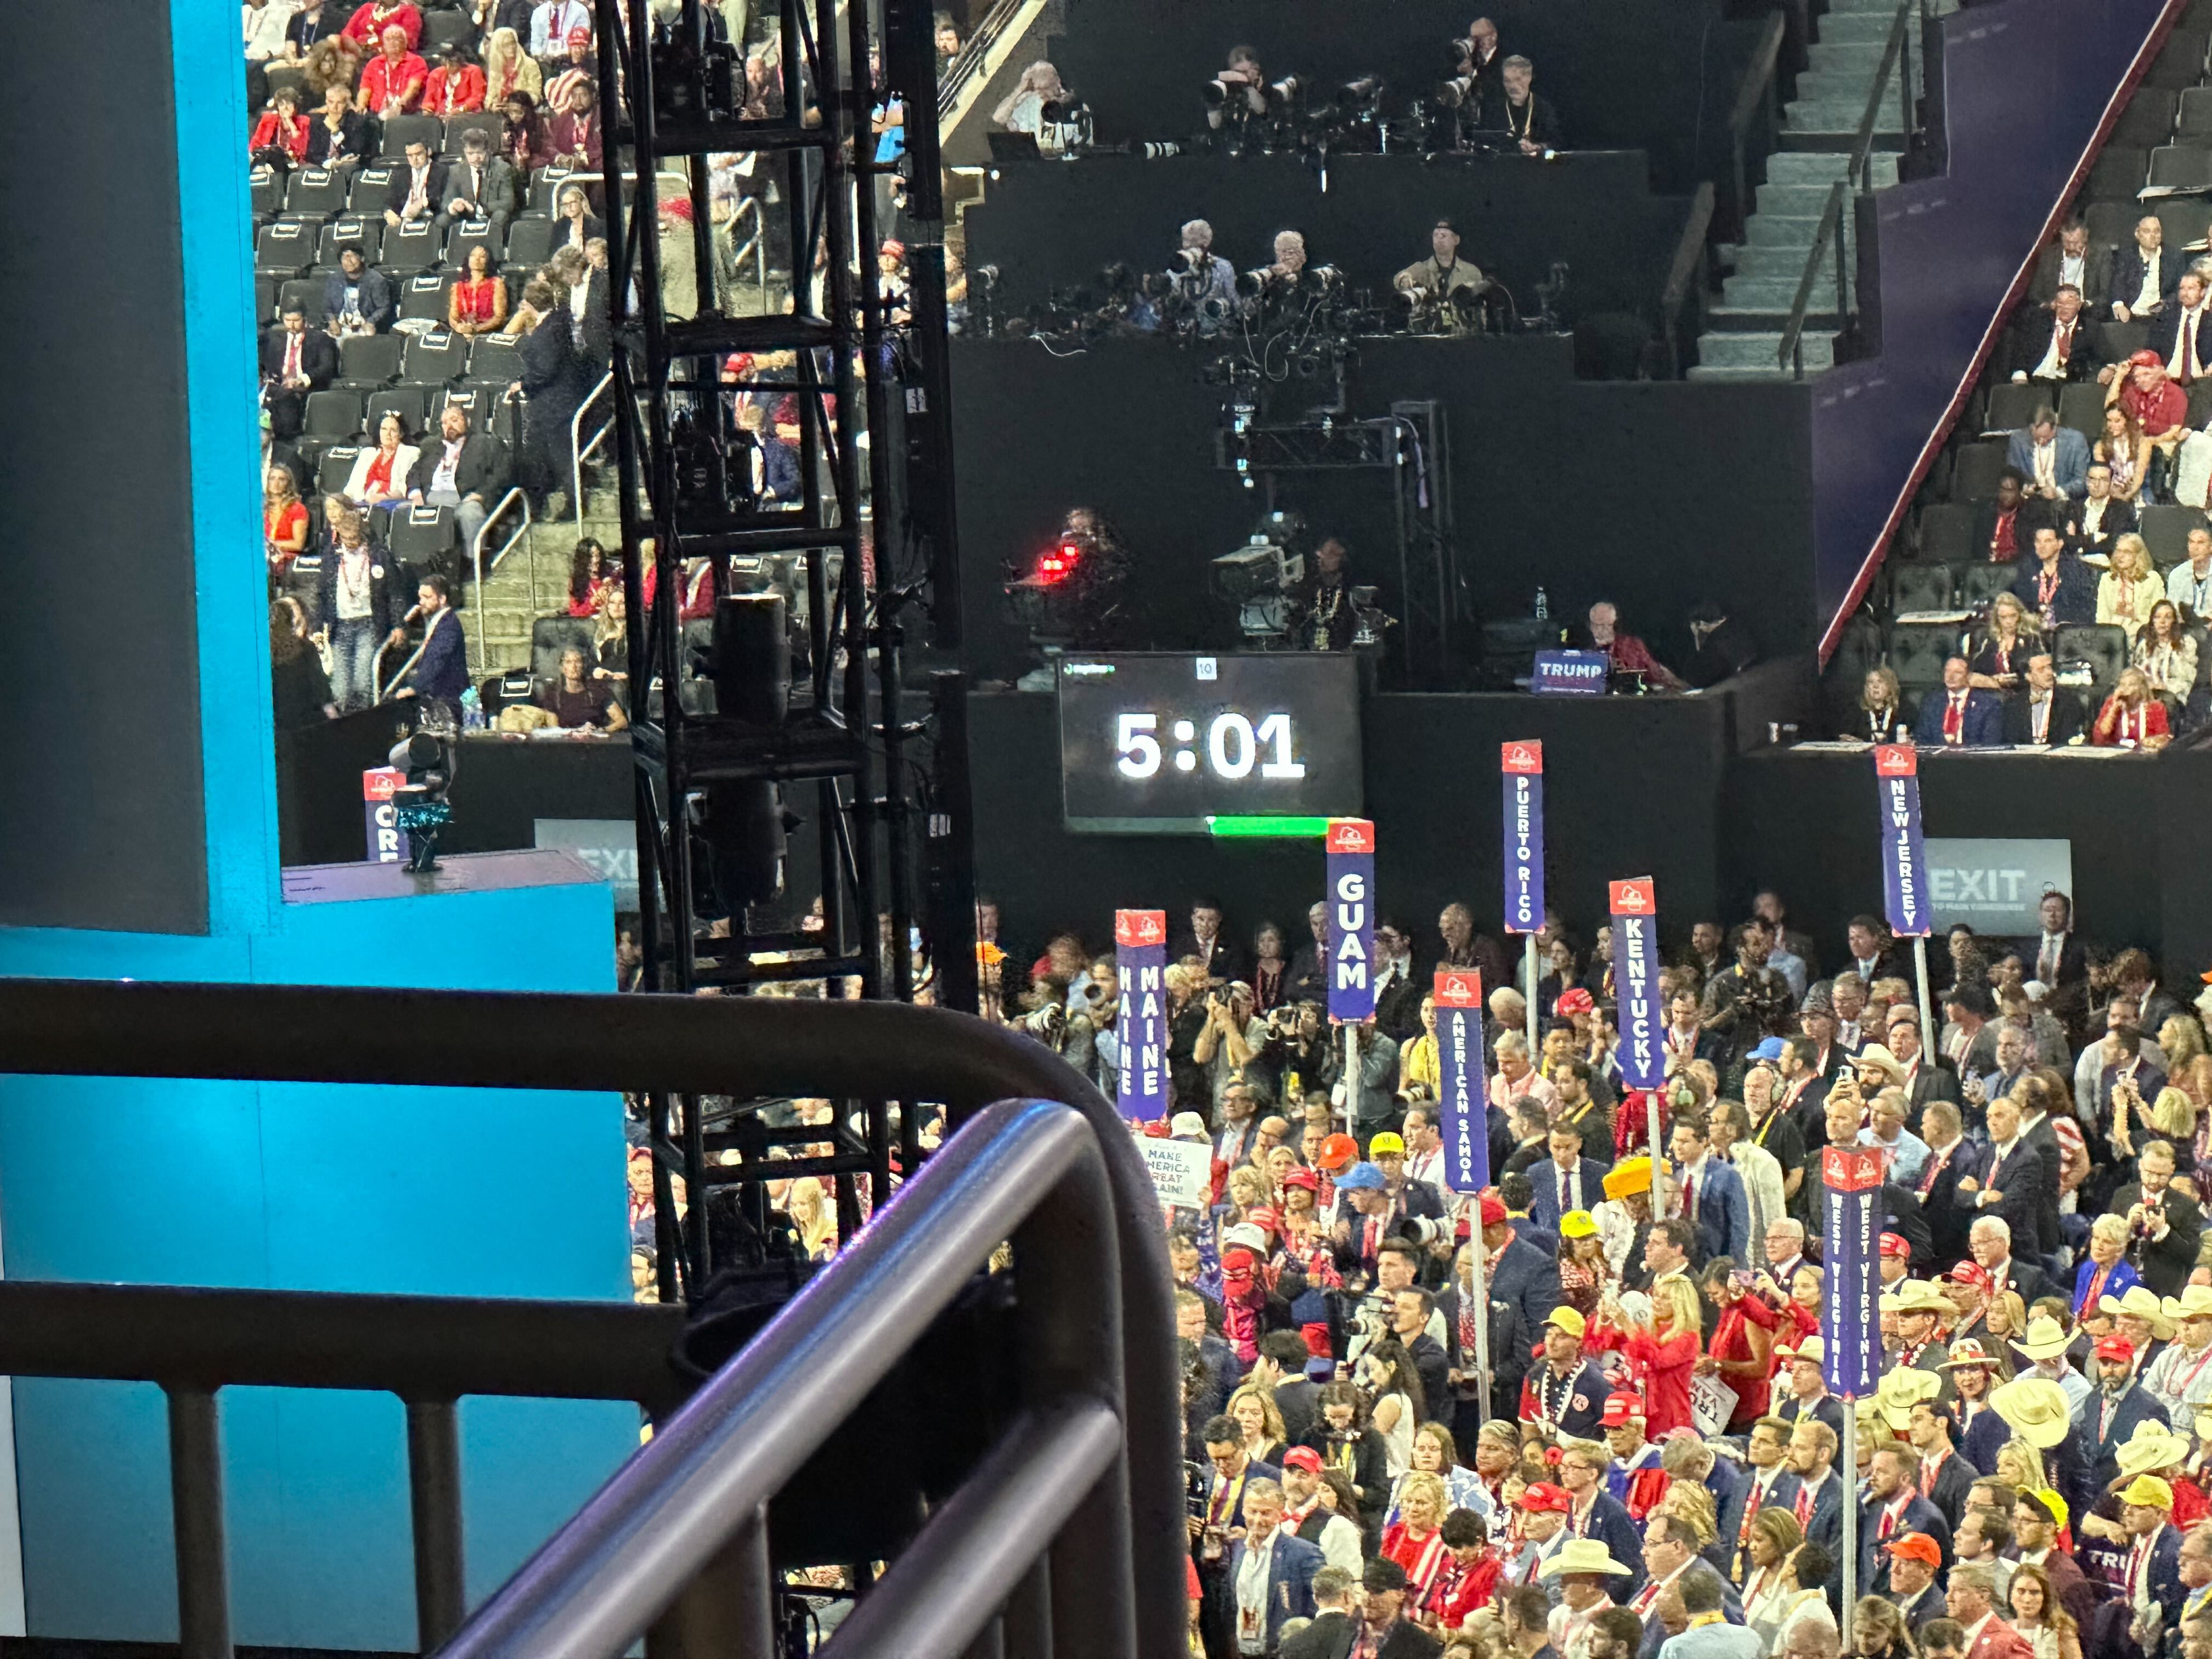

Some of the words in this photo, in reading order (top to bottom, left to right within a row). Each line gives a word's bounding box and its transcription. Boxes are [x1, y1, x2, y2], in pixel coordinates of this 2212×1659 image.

[1199, 663, 1212, 674] 10
[1541, 663, 1602, 678] TRUMP
[1117, 713, 1305, 779] 5:01
[1517, 776, 1531, 861] PUERTO
[1891, 780, 1910, 827] NEW
[1518, 866, 1532, 923] RICO
[1897, 830, 1916, 928] JERSEY
[1930, 868, 2025, 901] EXIT
[1337, 873, 1366, 990] GUAM
[1625, 918, 1651, 1079] KENTUCKY
[1141, 966, 1159, 1096] MAINE
[1452, 1011, 1469, 1114] AMERICAN
[1147, 1161, 1190, 1173] MERICA
[1152, 1172, 1182, 1183] REAT
[1458, 1119, 1472, 1183] SAMOA
[1859, 1193, 1872, 1255] WEST
[1859, 1262, 1871, 1386] VIRGINIA
